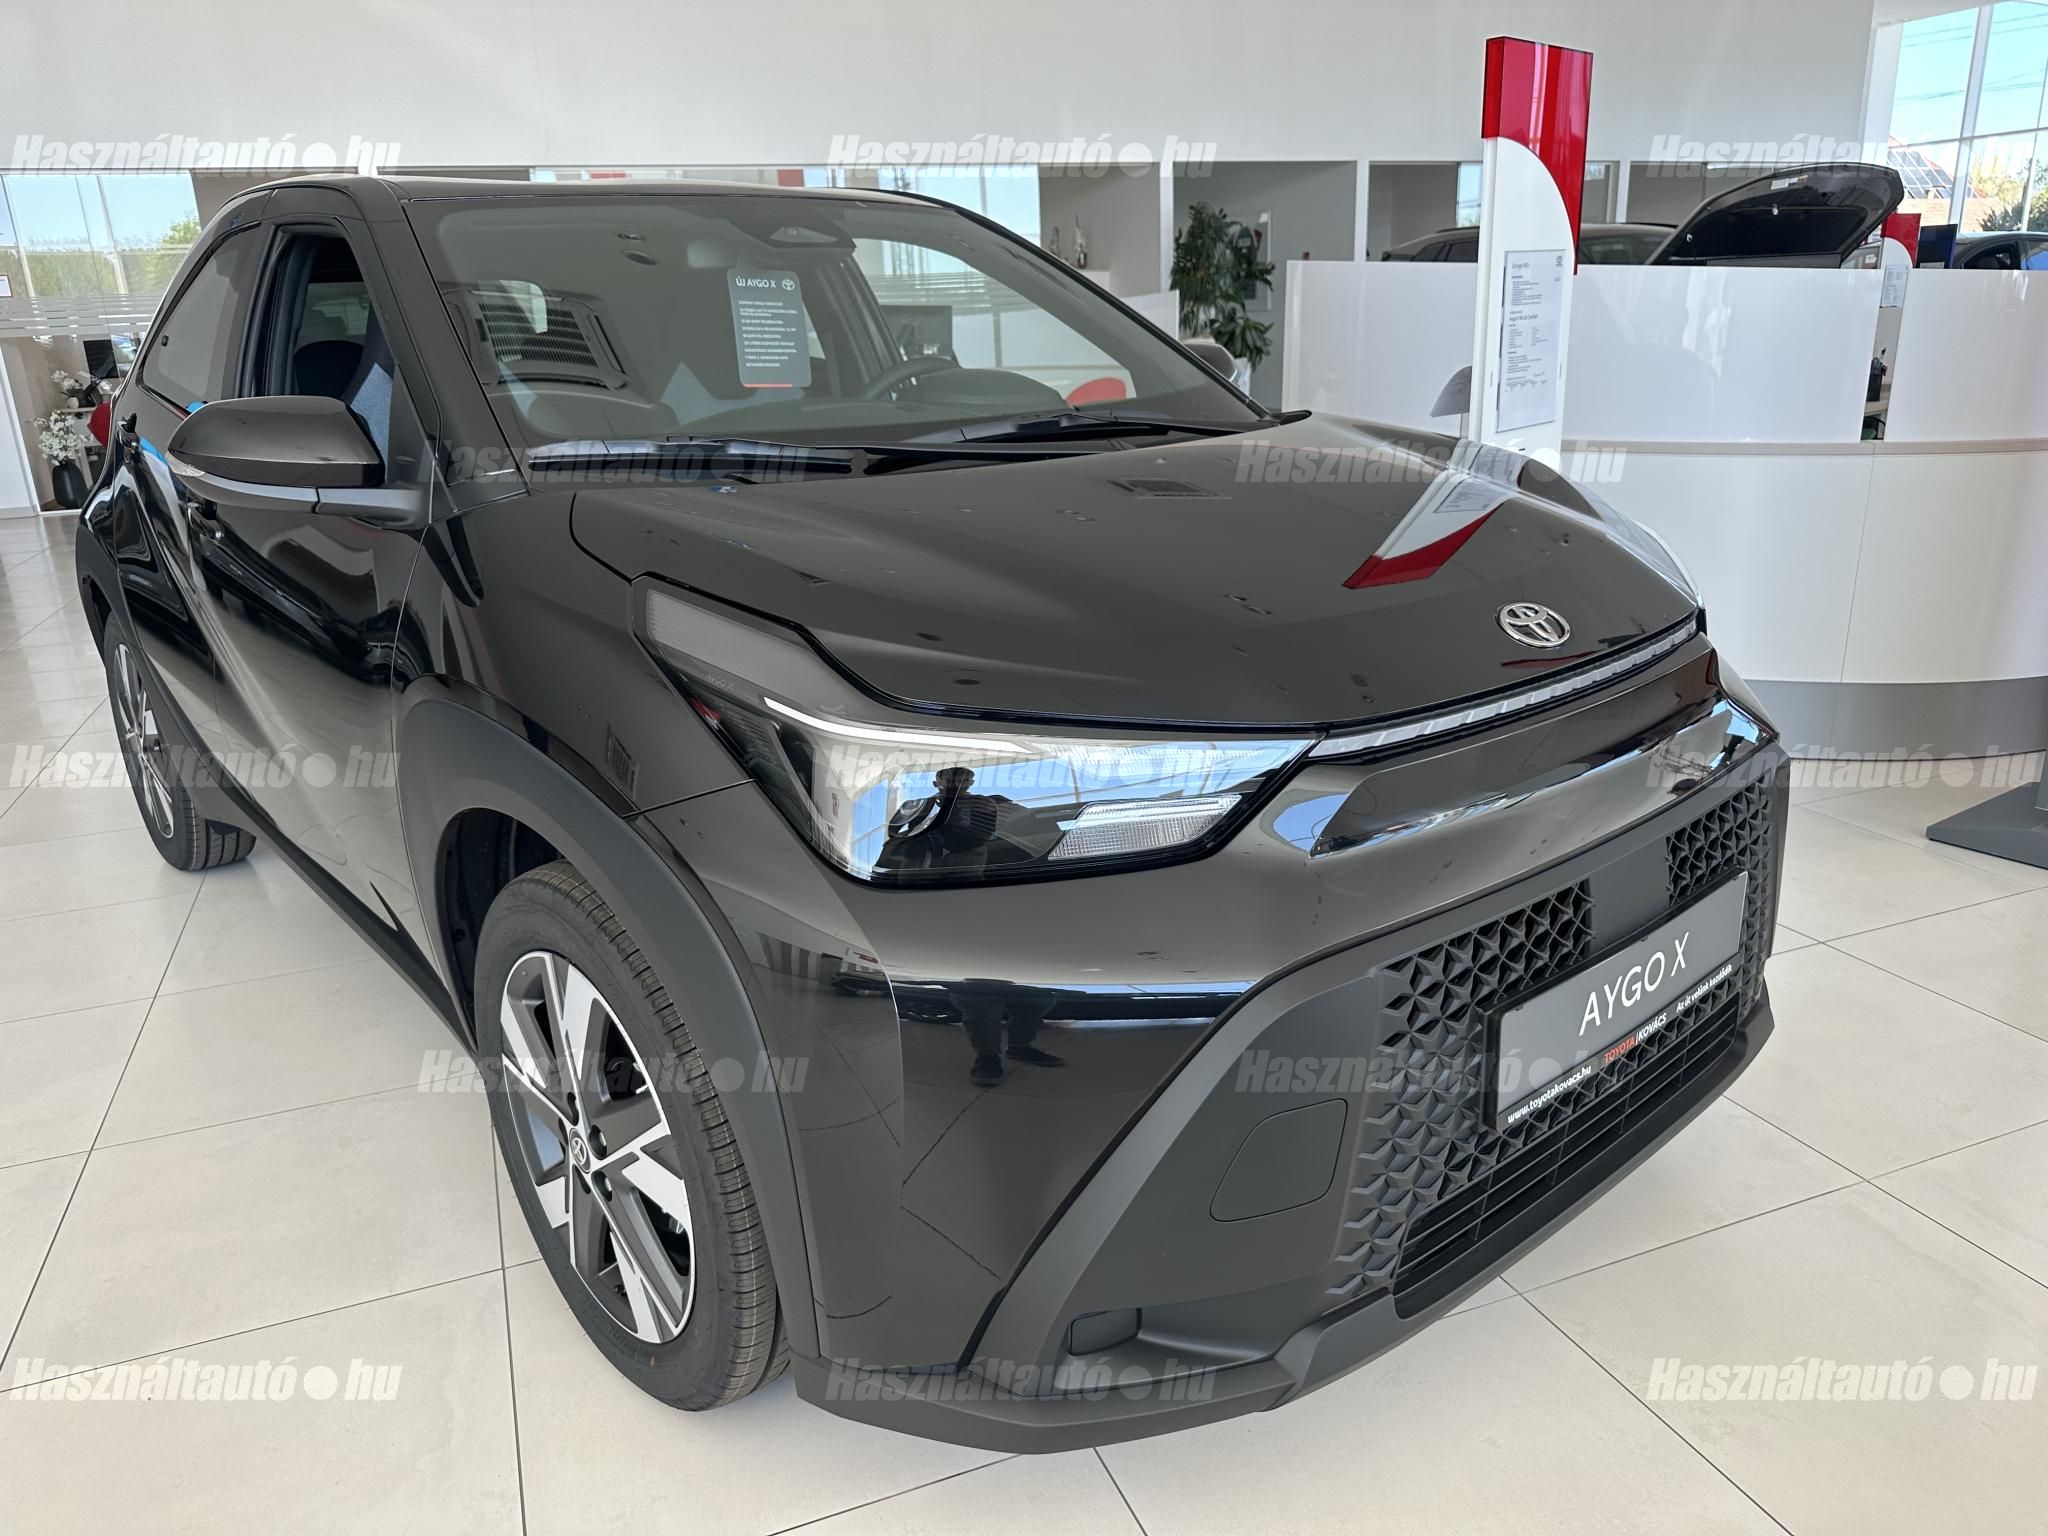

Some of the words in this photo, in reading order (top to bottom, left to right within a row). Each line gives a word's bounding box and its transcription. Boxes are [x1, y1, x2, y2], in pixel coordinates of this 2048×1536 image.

[735, 275, 746, 287] ÚJ
[747, 278, 769, 288] AYGO
[770, 280, 777, 288] X
[1578, 951, 1666, 1037] AYGO
[1671, 931, 1690, 977] X
[1507, 1065, 1592, 1124] www.toyotakovacs.hu
